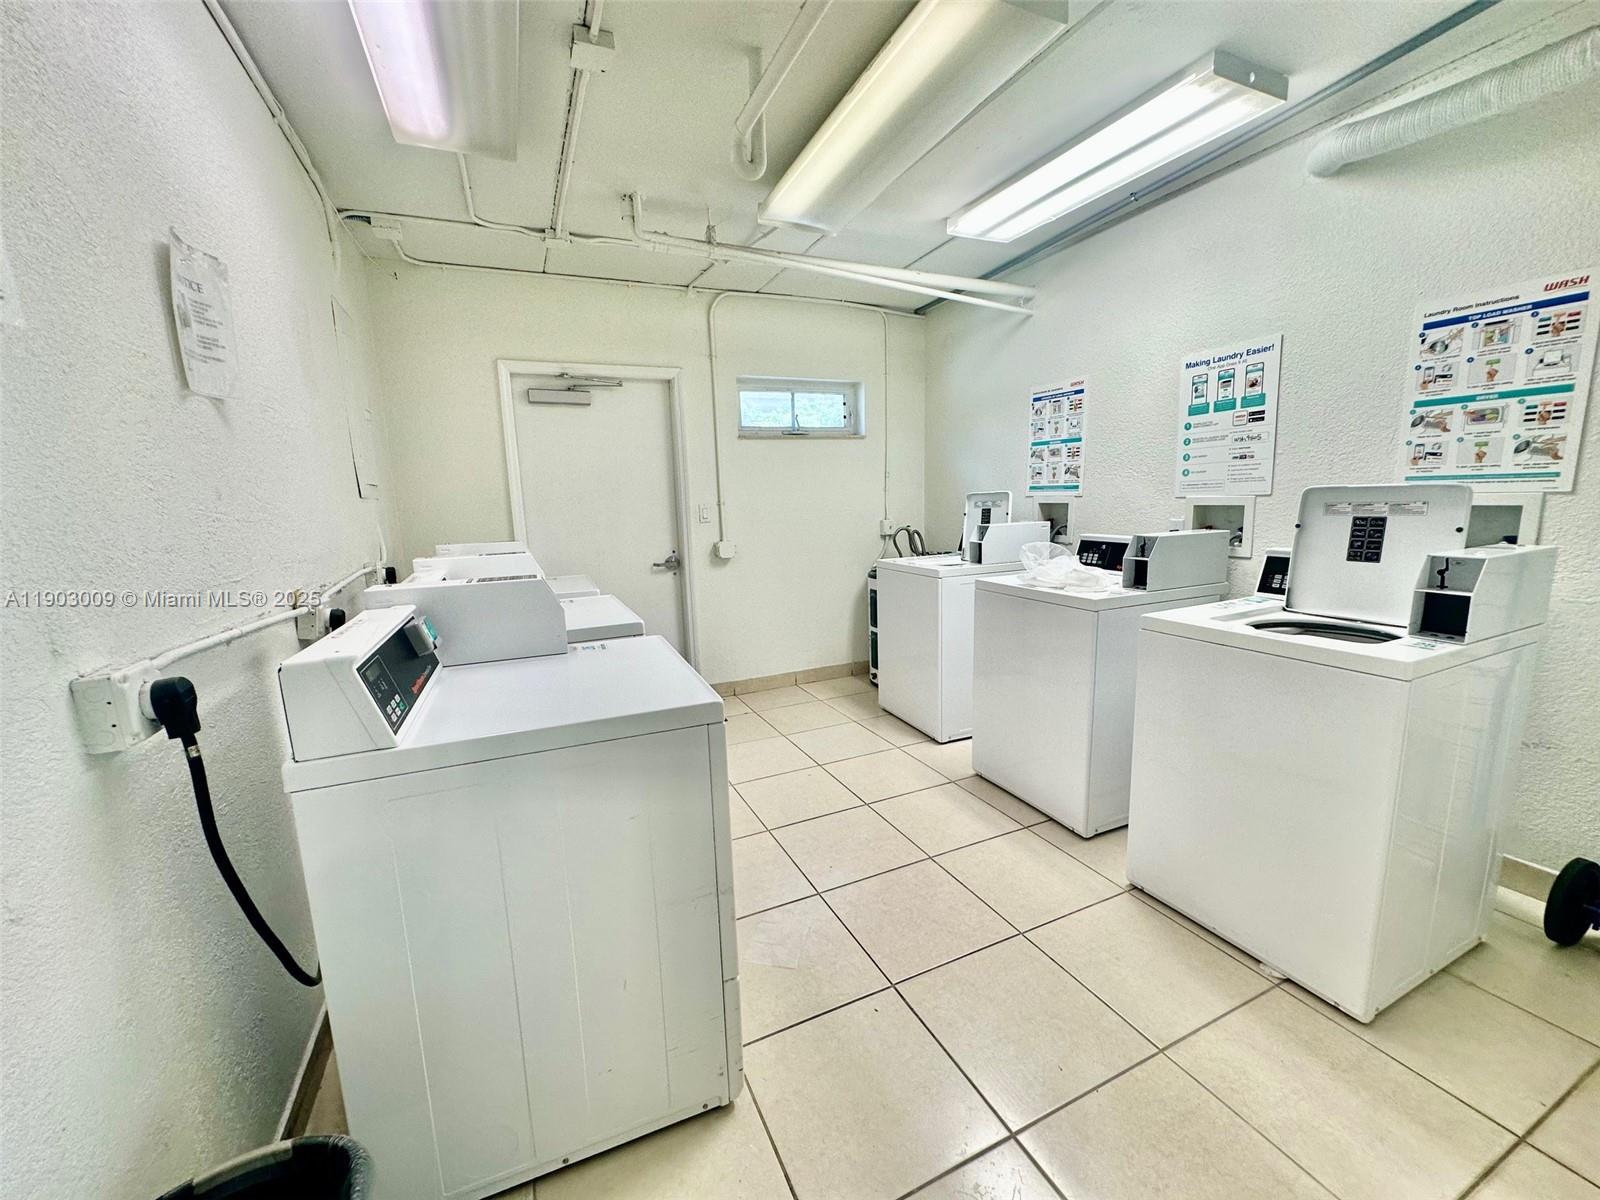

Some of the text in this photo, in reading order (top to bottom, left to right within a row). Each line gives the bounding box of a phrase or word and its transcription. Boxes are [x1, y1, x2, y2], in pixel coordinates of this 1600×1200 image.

[1543, 274, 1591, 292] WASH
[1423, 307, 1451, 318] Laundry
[1452, 303, 1474, 313] Room
[1468, 313, 1482, 321] TOP
[1482, 310, 1501, 319] LOAD
[1185, 343, 1275, 369] Making Laundry Easier!
